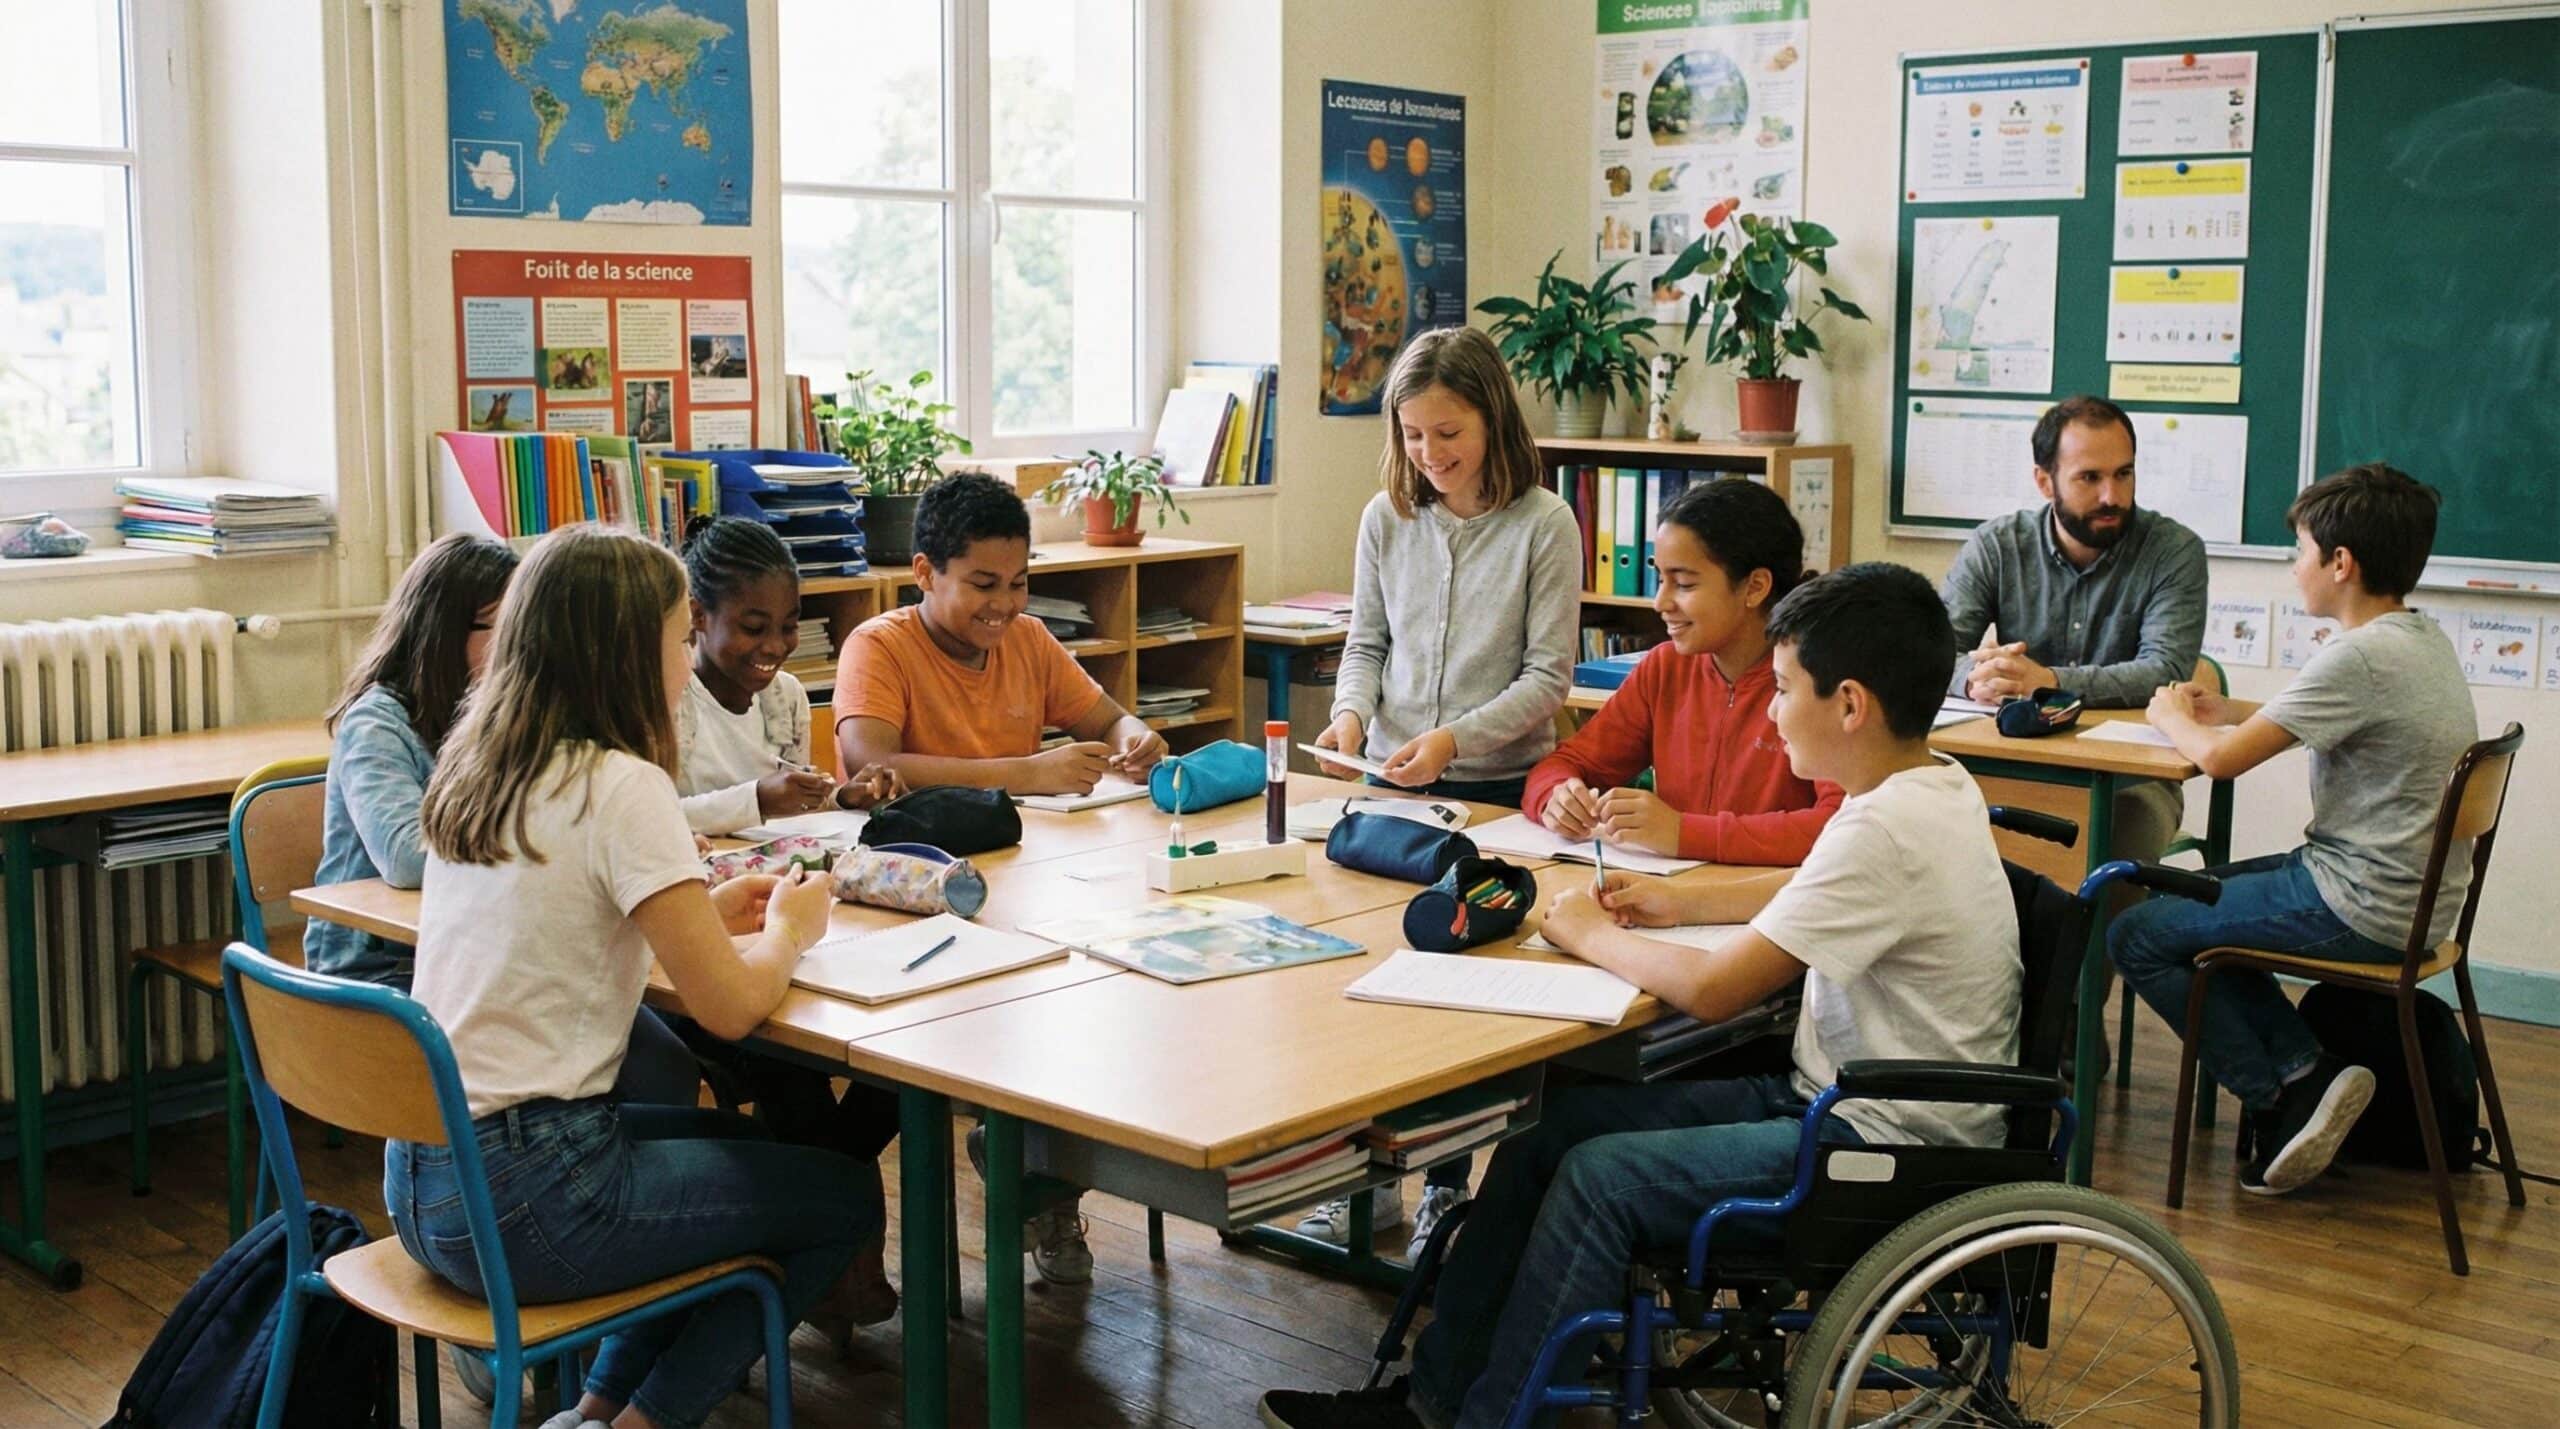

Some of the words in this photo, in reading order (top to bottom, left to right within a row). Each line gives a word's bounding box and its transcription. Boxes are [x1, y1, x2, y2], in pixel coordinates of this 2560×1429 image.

[1623, 4, 1693, 22] Sciences
[575, 260, 599, 280] de
[603, 260, 620, 280] la
[625, 262, 693, 281] science
